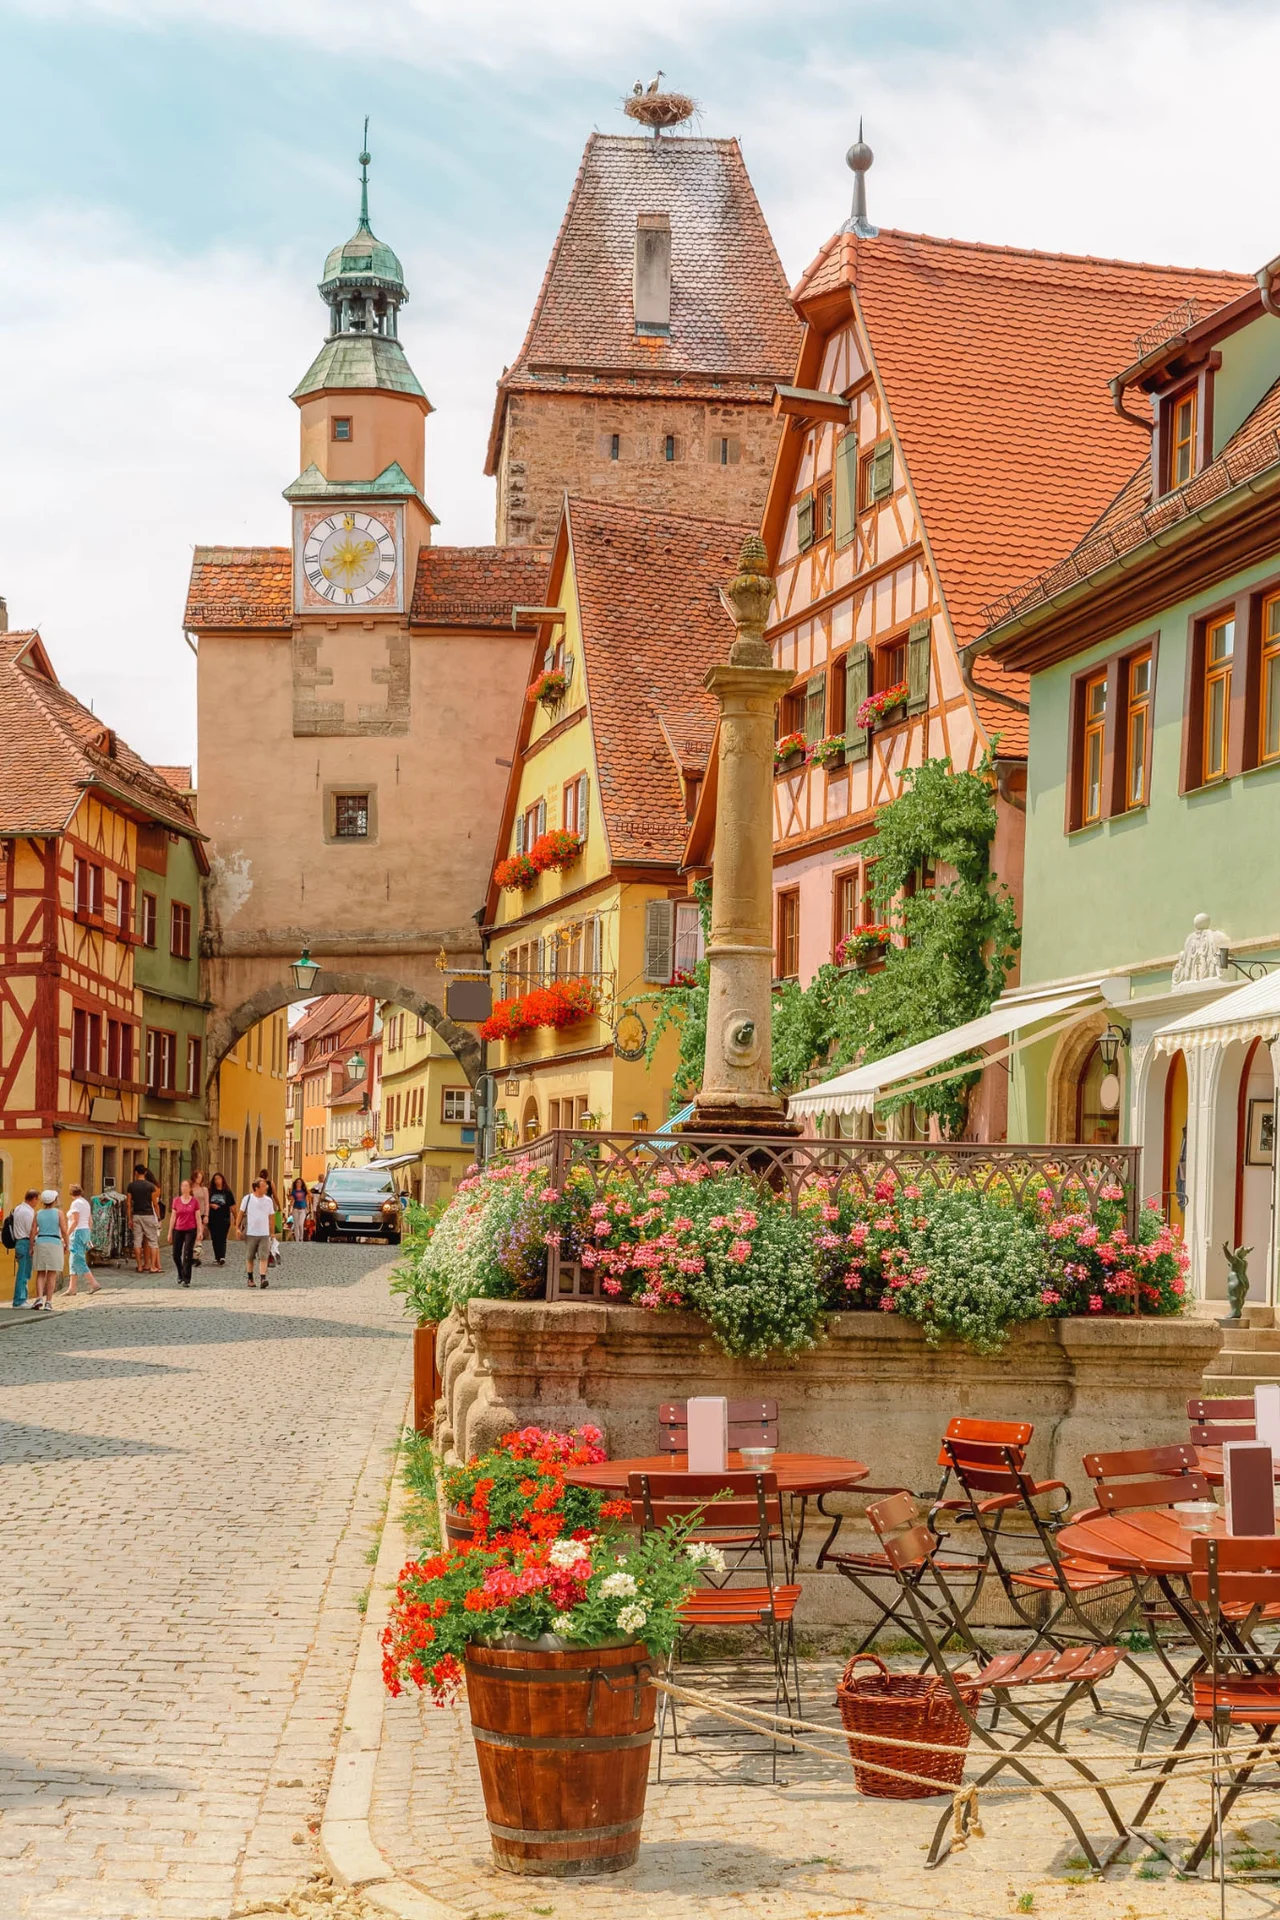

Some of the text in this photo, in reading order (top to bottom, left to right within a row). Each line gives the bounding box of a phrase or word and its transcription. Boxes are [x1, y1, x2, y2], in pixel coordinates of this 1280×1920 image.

[365, 518, 373, 530] I
[377, 533, 390, 544] II
[381, 553, 395, 562] III
[308, 569, 324, 588] VIII
[375, 570, 391, 586] IIII
[323, 583, 337, 600] VII
[365, 586, 377, 599] V
